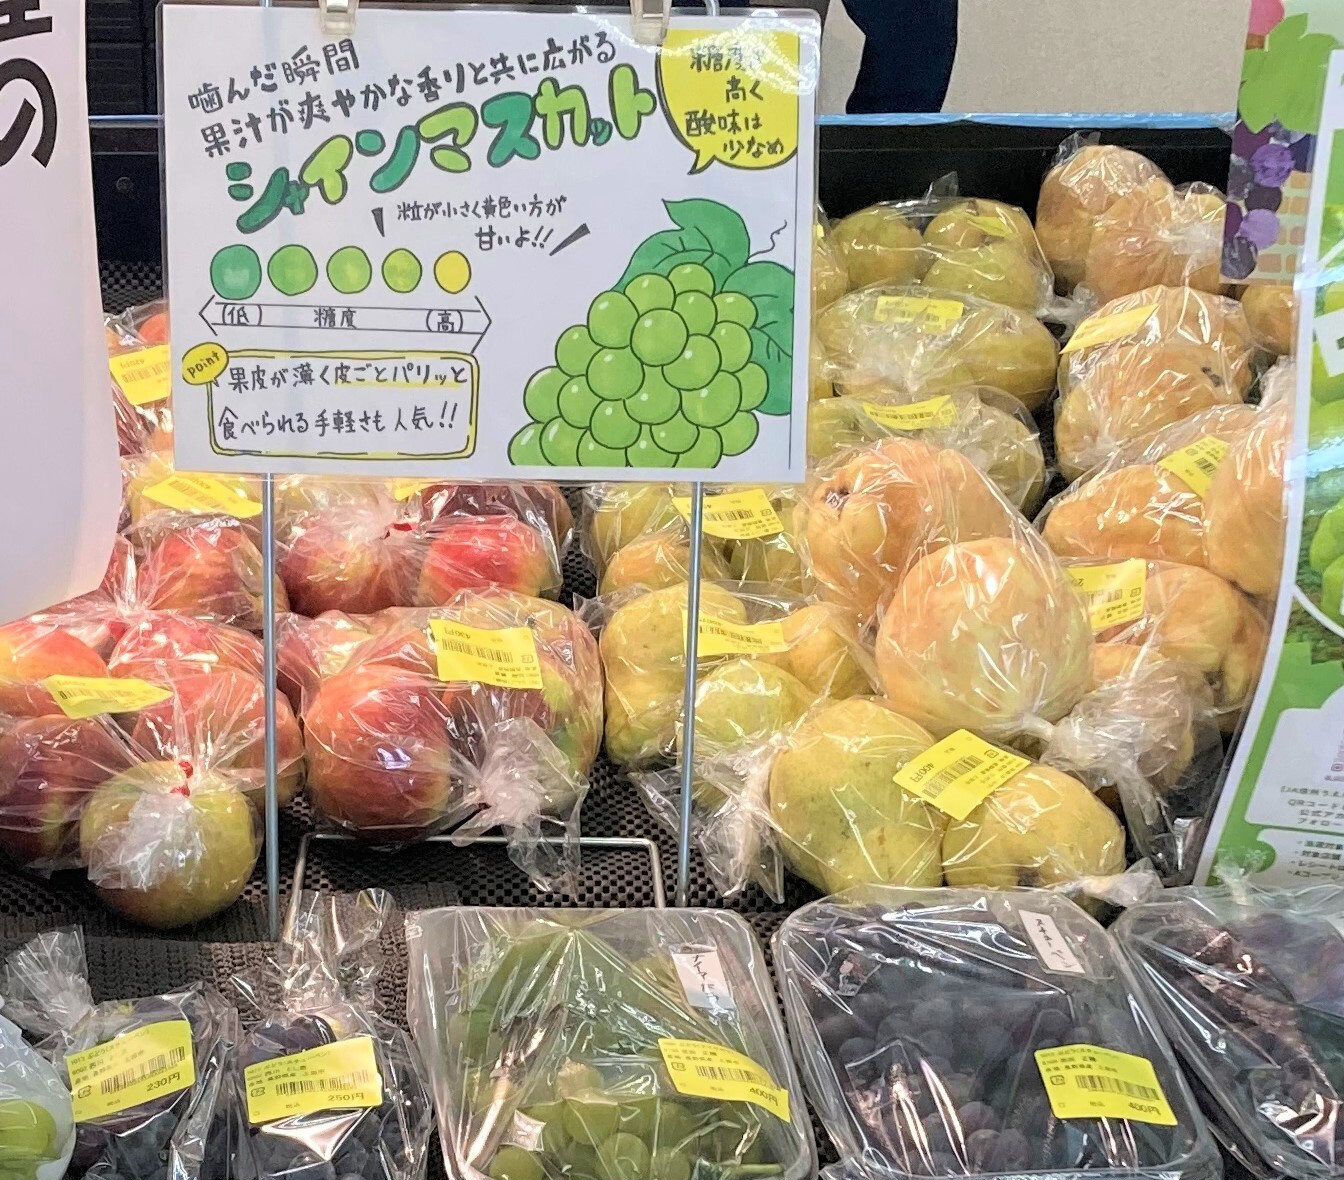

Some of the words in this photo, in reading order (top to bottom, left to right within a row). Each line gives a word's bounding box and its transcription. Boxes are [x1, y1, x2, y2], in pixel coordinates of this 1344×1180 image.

[187, 38, 359, 113] 噛んだ瞬間
[725, 75, 764, 102] 高く
[201, 31, 616, 158] 果汁が爽やかな香りと共に広がる
[685, 110, 763, 136] 酸味は
[225, 63, 657, 234] シャインマスカット
[722, 137, 784, 160] 少なめ
[397, 193, 567, 222] 粒が小さく黄色い方が
[474, 224, 554, 250] 甘いよ!!
[314, 307, 357, 329] 糖度
[187, 351, 222, 379] point
[228, 362, 468, 393] 果皮が薄く皮ごとパリッと
[147, 1072, 180, 1091] 230円
[328, 1093, 364, 1101] 250円
